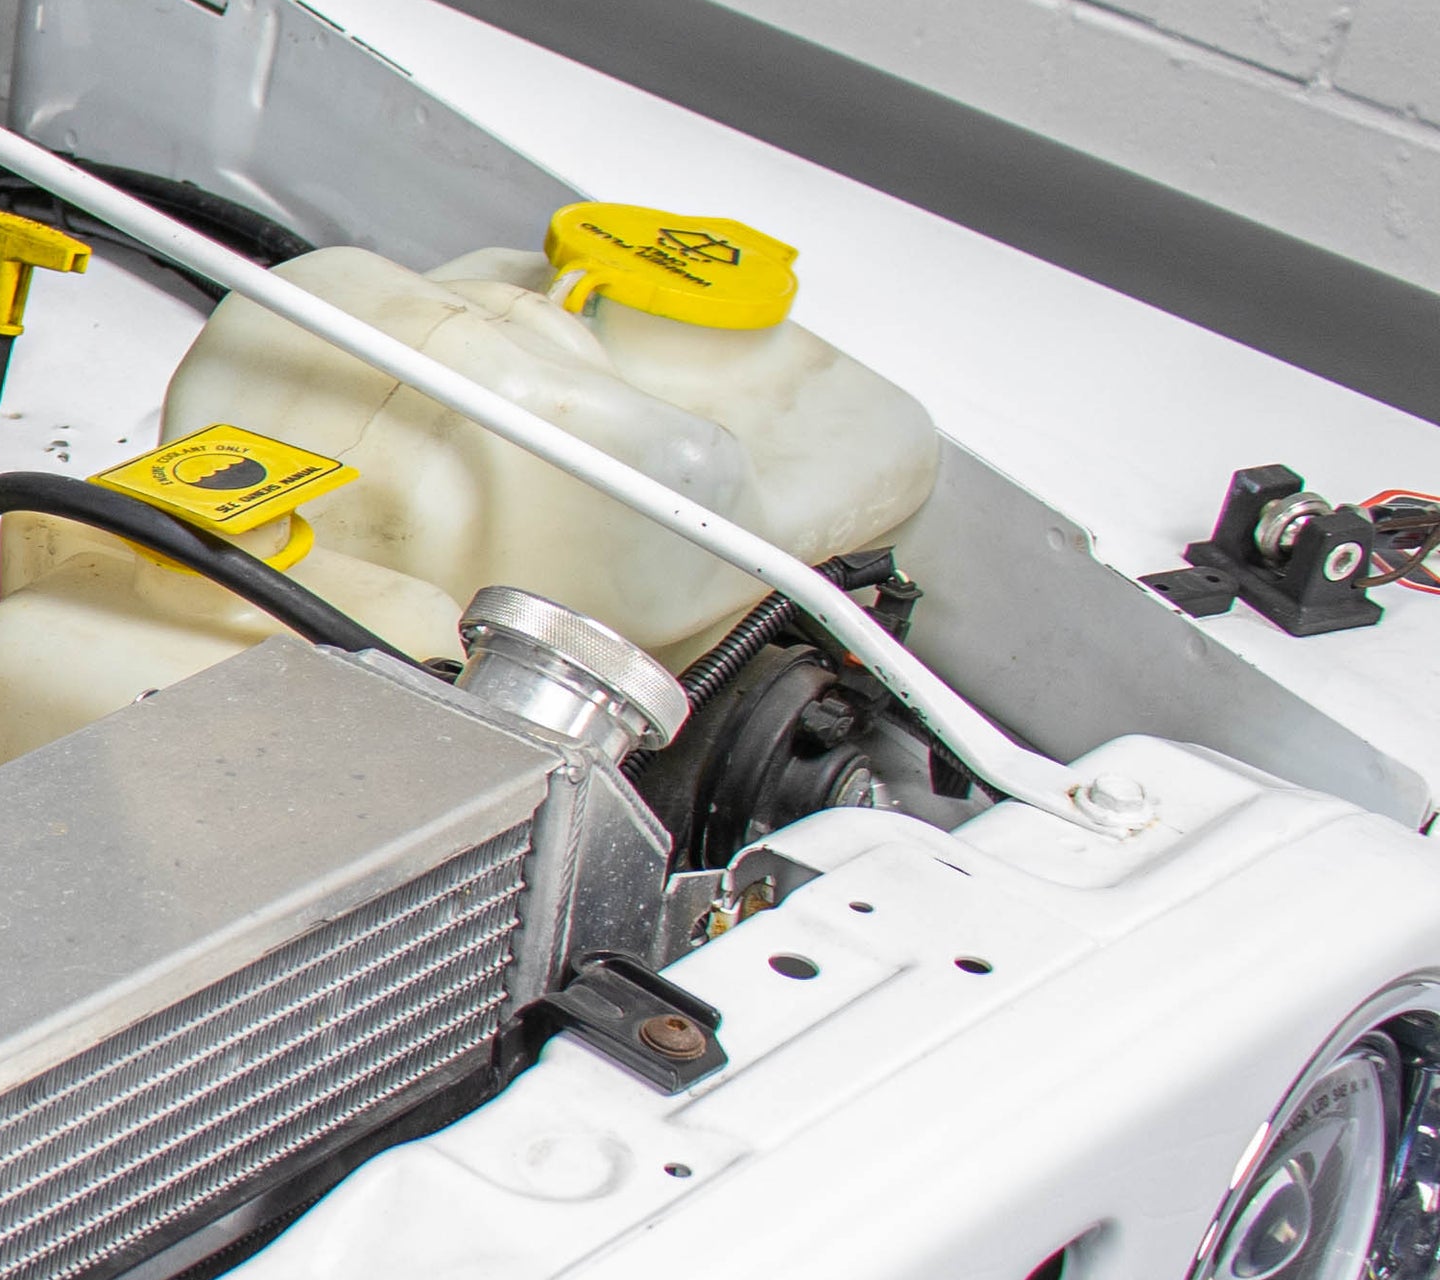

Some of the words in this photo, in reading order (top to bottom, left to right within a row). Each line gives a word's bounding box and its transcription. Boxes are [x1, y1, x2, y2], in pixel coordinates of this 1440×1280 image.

[157, 445, 207, 465] COOLANT
[215, 445, 251, 455] ONLY
[214, 501, 241, 515] SEE
[280, 465, 323, 486] MANUAL
